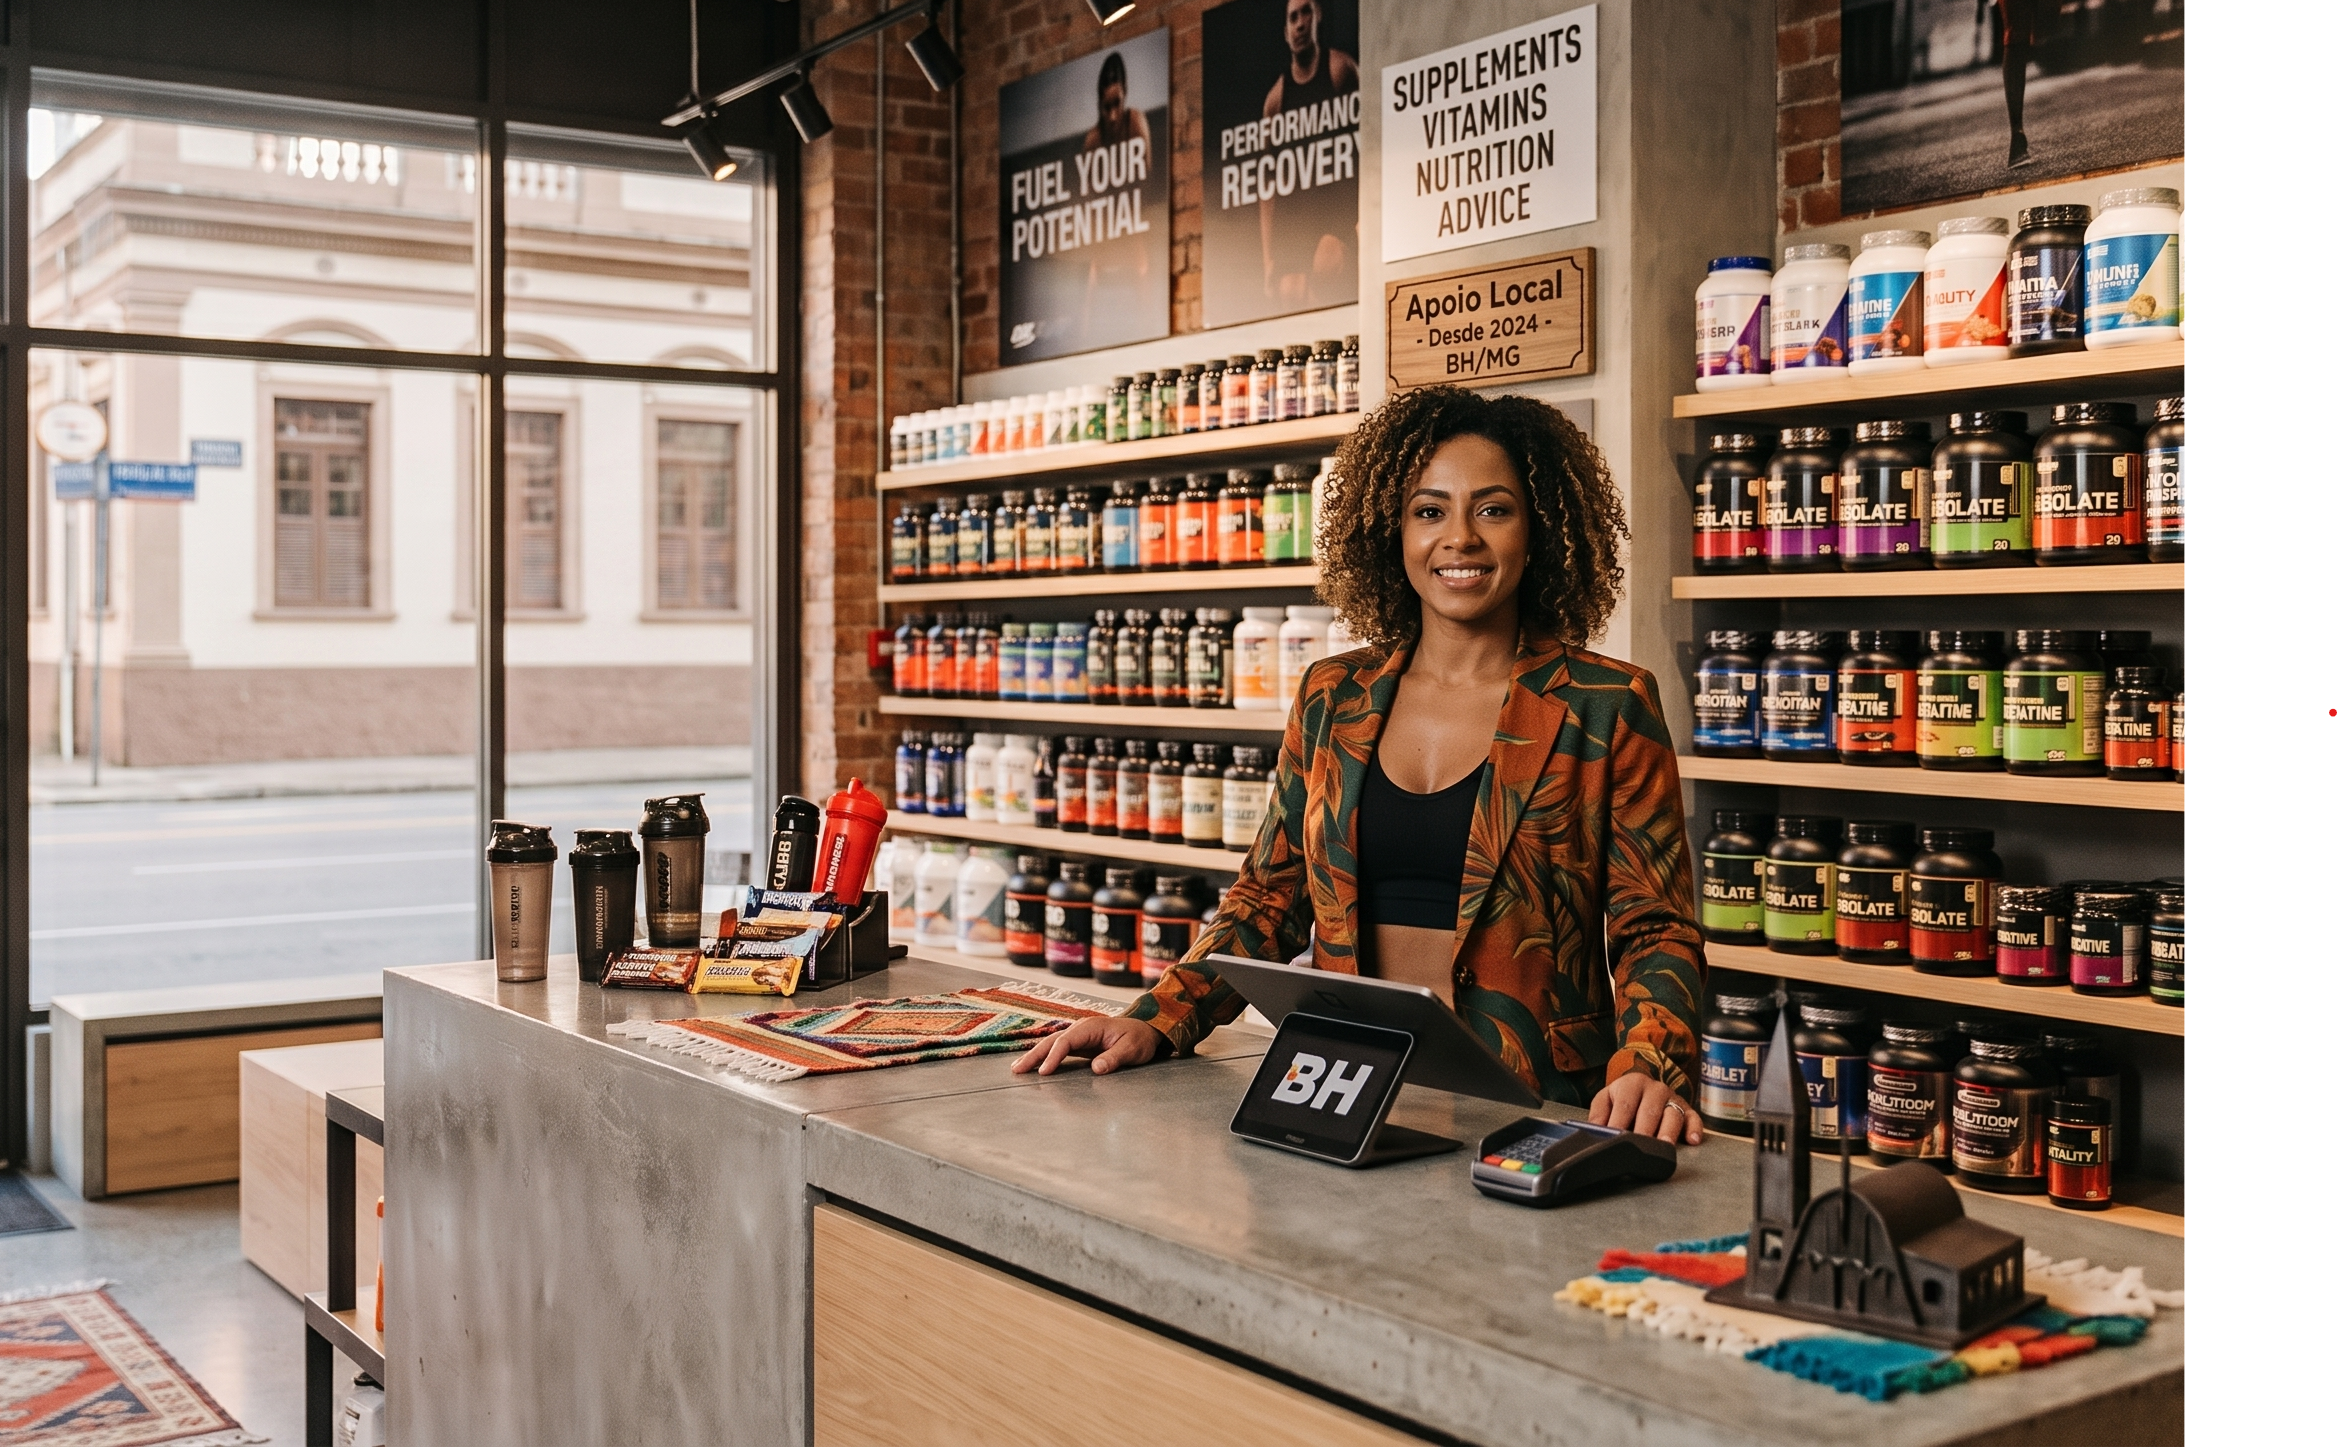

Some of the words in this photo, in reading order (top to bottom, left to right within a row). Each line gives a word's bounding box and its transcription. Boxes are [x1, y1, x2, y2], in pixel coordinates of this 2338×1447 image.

[1393, 24, 1582, 112] SUPPLEMENTS
[1422, 83, 1547, 149] VITAMINS
[1012, 160, 1071, 214] FUEL
[1075, 136, 1146, 197] YOUR
[1417, 129, 1554, 197] NUTRITION
[1012, 188, 1150, 262] POTENTIAL
[1437, 182, 1530, 237] ADVICE
[1405, 284, 1481, 325] Apoio
[1490, 269, 1562, 308] Local
[1429, 322, 1484, 347] Desde
[1490, 313, 1538, 340] 2024
[1446, 345, 1520, 375] BH/MG
[1994, 540, 2008, 550] 20
[1271, 1052, 1374, 1116] BH
